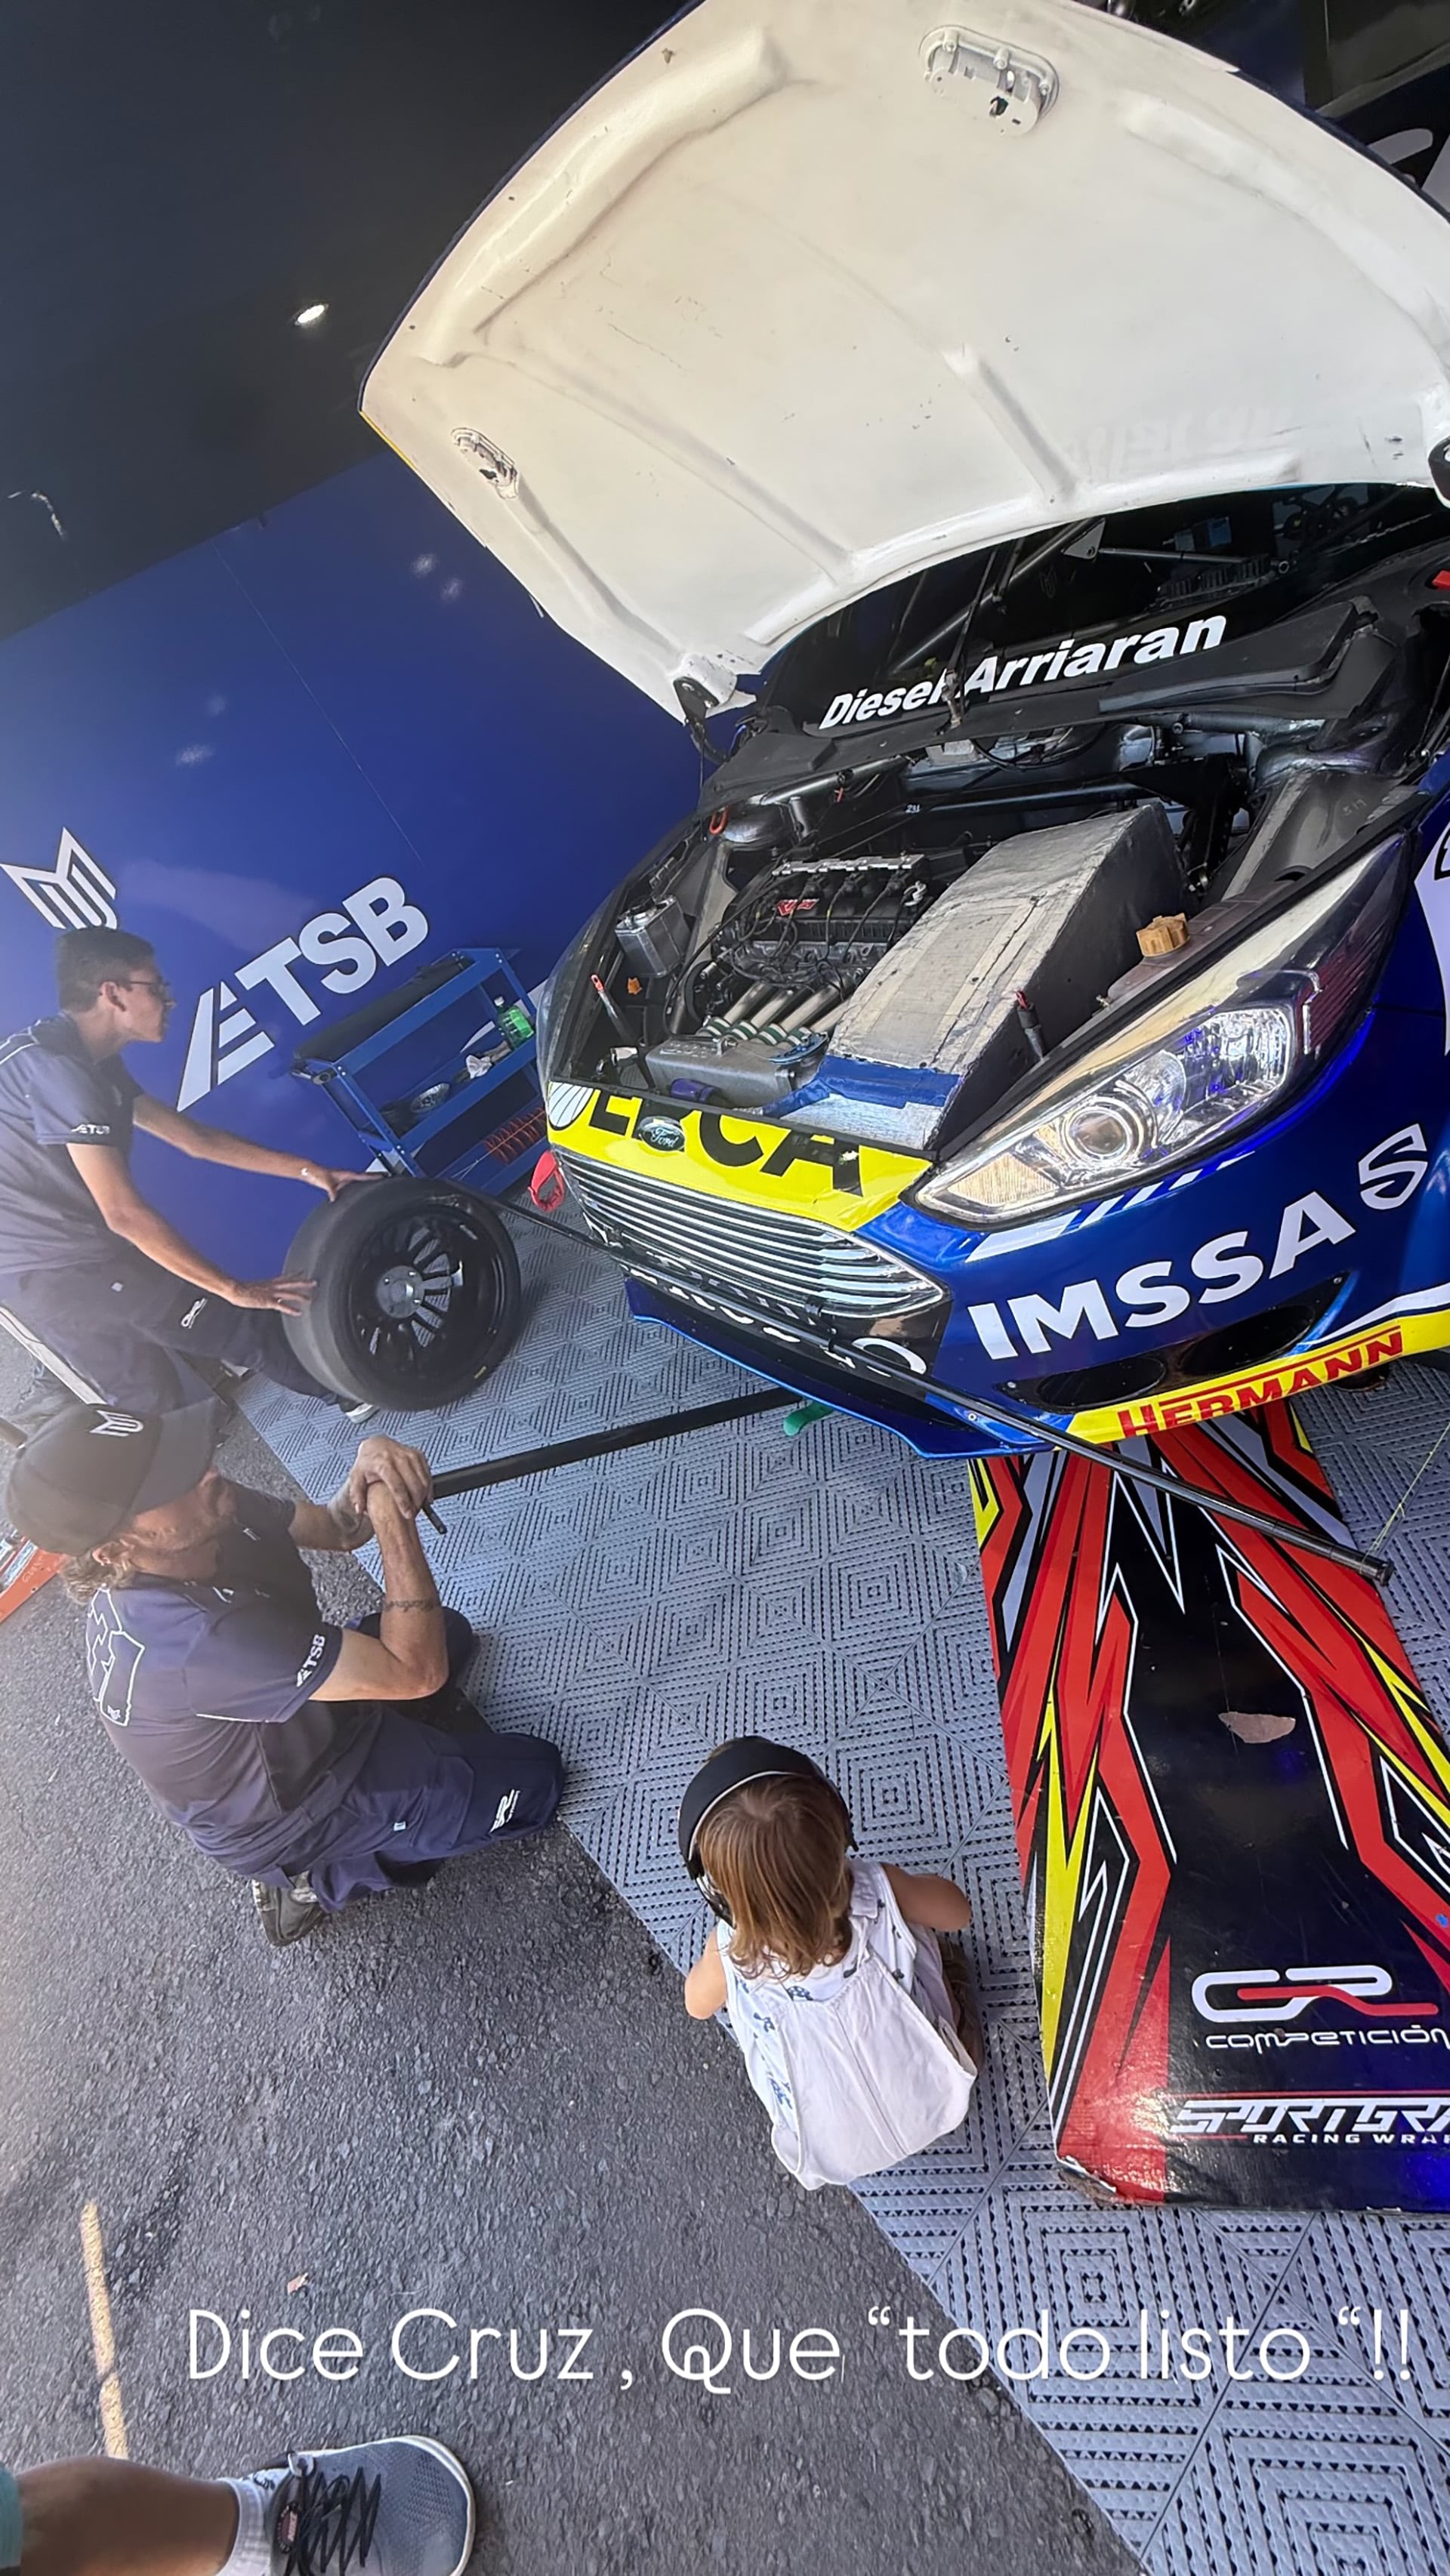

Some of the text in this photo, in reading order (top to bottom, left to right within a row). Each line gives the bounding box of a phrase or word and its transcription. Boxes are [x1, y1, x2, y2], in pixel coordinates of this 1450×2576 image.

[819, 615, 1227, 730] Diesel Arriaran
[649, 1126, 679, 1148] Ford
[968, 1191, 1356, 1360] IMSSA
[1117, 1331, 1403, 1438] HERMANN
[1253, 2133, 1360, 2144] RACING
